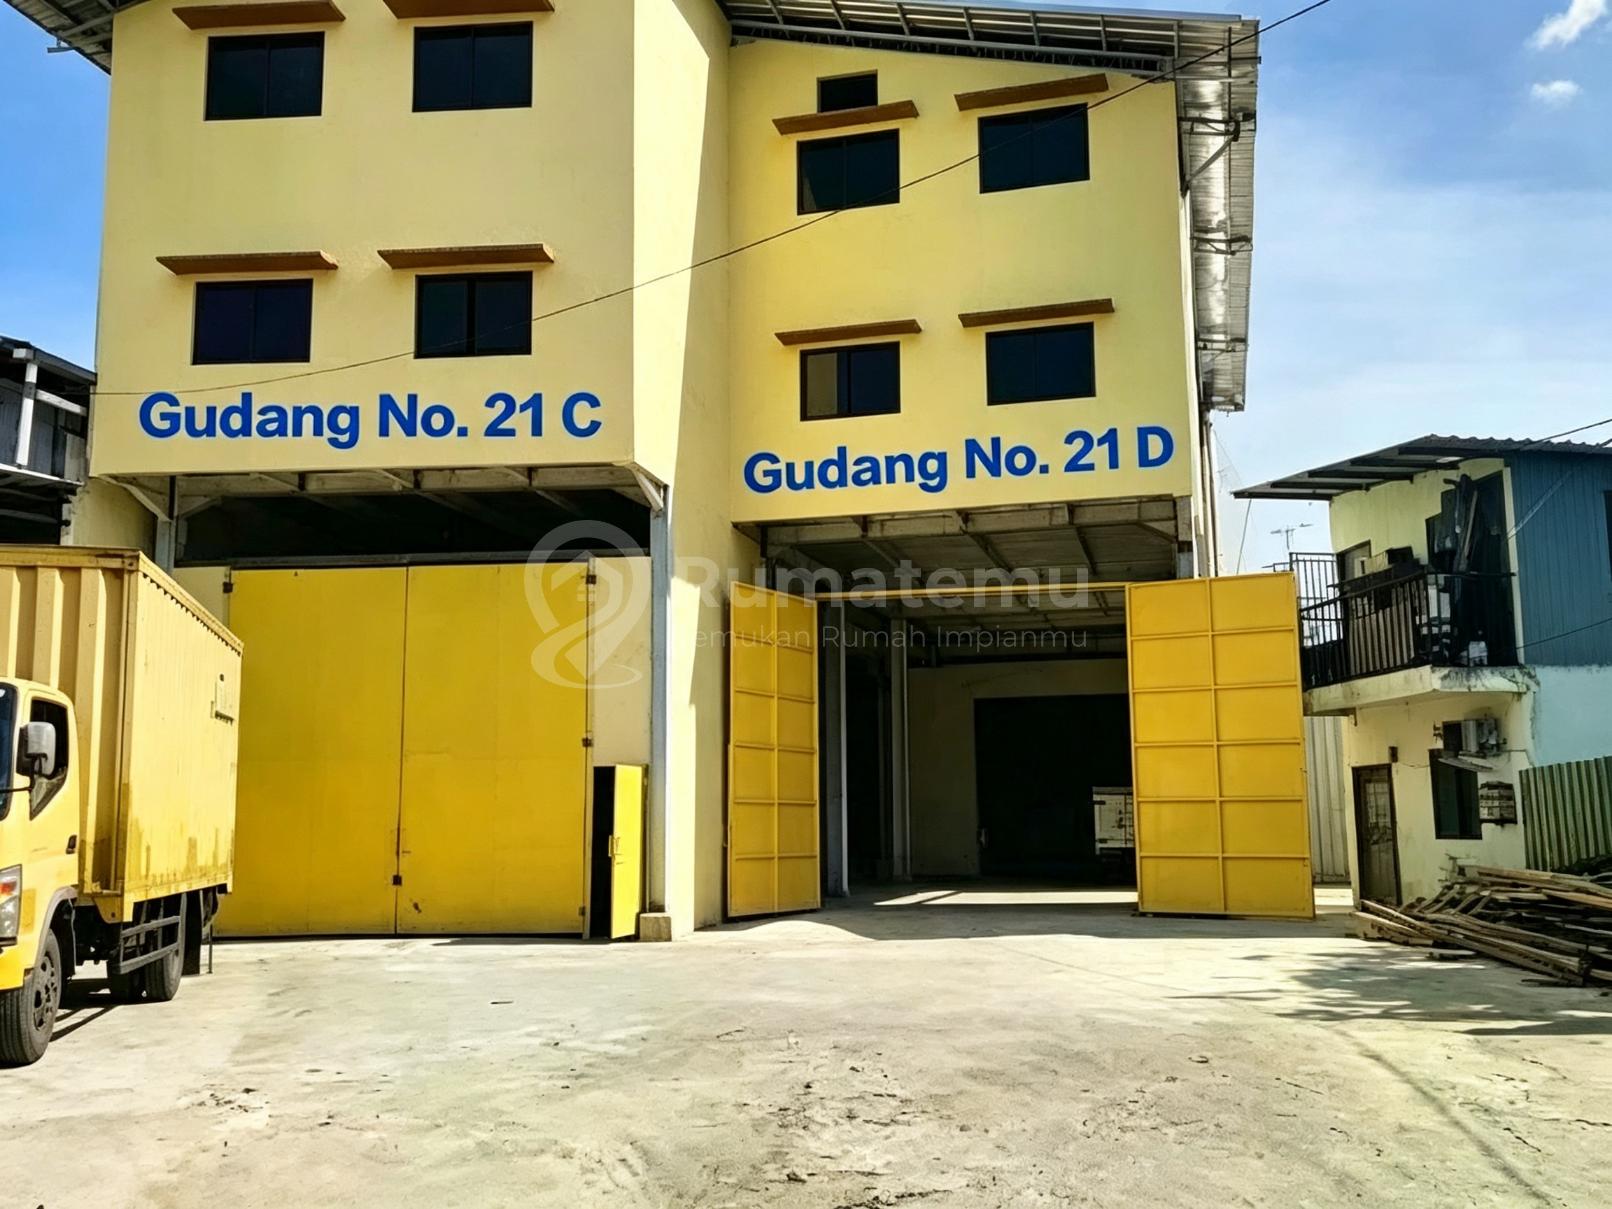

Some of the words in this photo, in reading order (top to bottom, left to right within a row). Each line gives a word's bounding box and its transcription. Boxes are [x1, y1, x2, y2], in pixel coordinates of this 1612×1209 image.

[139, 391, 361, 449] Gudang
[378, 392, 469, 439] No.
[484, 391, 543, 438] 21
[561, 391, 602, 438] C
[743, 446, 949, 494] Gudang
[964, 436, 1049, 480] No.
[1063, 427, 1120, 473] 21
[1136, 425, 1175, 469] D
